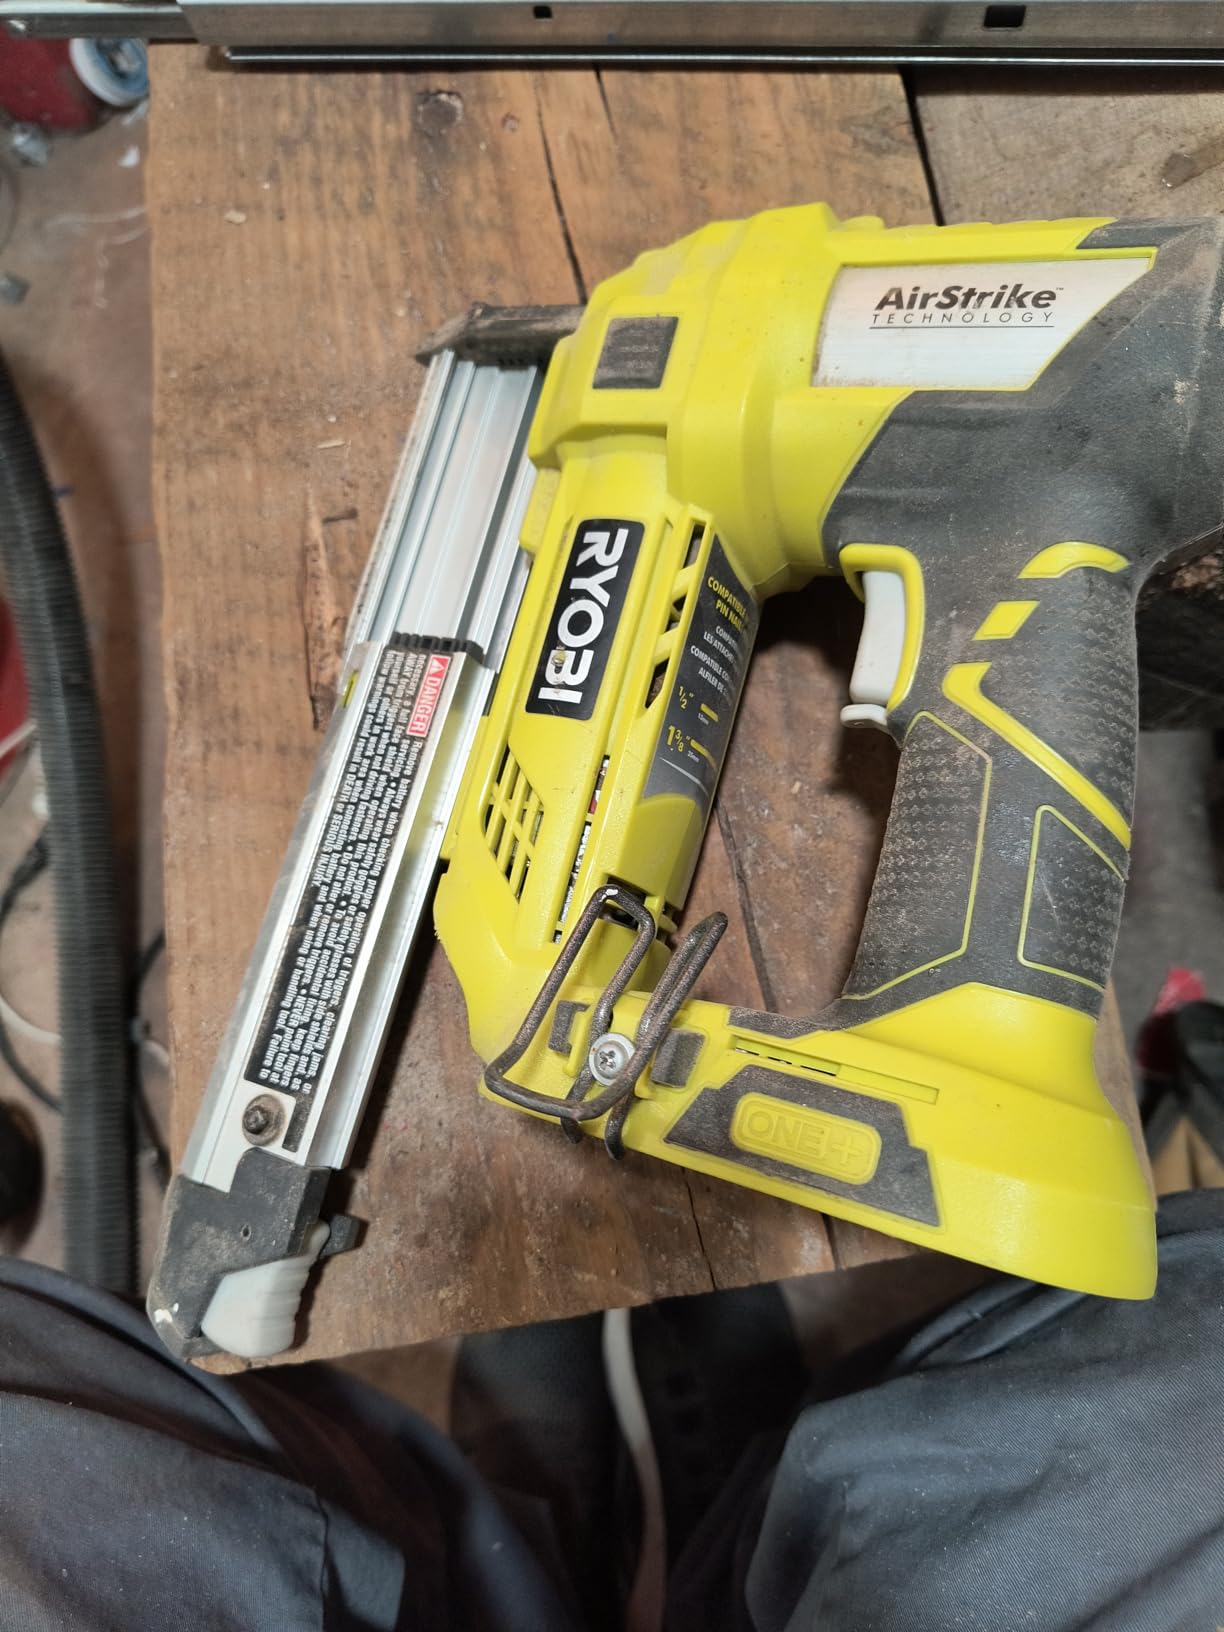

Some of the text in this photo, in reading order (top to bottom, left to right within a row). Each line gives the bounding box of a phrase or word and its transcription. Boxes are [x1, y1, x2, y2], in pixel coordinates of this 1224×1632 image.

[872, 312, 1054, 324] TECHNOLOGY
[537, 528, 629, 704] RYOBI
[715, 599, 730, 618] PIN
[703, 631, 714, 645] LES
[379, 649, 396, 675] follow
[386, 650, 406, 684] yourself
[401, 652, 417, 677] AWAY
[690, 645, 722, 676] COMPATIBLE
[365, 675, 388, 713] warnings
[384, 686, 393, 695] or
[395, 677, 409, 697] from
[375, 696, 391, 723] others
[382, 698, 403, 731] triggers
[397, 708, 410, 723] full
[410, 676, 441, 732] DANGER
[359, 714, 375, 737] could
[371, 725, 382, 734] in
[391, 724, 404, 743] face
[350, 738, 367, 763] result
[364, 736, 379, 757] work
[376, 731, 392, 755] when
[347, 762, 359, 773] in
[357, 758, 370, 777] area
[371, 755, 384, 770] not
[381, 745, 398, 772] shield
[403, 741, 422, 775] Remove
[338, 773, 356, 802] DEATH
[349, 779, 365, 803] when
[360, 770, 379, 800] driving
[373, 774, 388, 797] when
[391, 777, 410, 808] battery
[334, 803, 345, 813] or
[376, 787, 396, 819] Always
[332, 804, 357, 850] connecting
[358, 799, 380, 840] operating
[370, 819, 384, 842] wear
[384, 811, 400, 835] when
[321, 813, 343, 852] SERIOUS
[340, 851, 353, 865] Do
[353, 842, 366, 859] this
[360, 841, 378, 868] safety
[369, 837, 391, 876] checking
[321, 852, 341, 883] battery
[335, 865, 348, 881] not
[317, 884, 331, 902] and
[328, 881, 343, 902] alter
[348, 869, 369, 904] goggles
[358, 878, 377, 909] proper
[308, 903, 325, 928] when
[324, 903, 335, 913] or
[333, 908, 345, 919] To
[346, 905, 356, 915] or
[313, 914, 331, 947] remove
[325, 921, 341, 947] avoid
[336, 915, 355, 943] safety
[344, 911, 368, 954] operation
[298, 929, 316, 955] using
[295, 956, 306, 967] or
[309, 948, 332, 996] accidental
[324, 943, 346, 979] glasses
[341, 956, 354, 967] of
[280, 968, 303, 1008] handling
[319, 979, 334, 999] with
[287, 995, 306, 1027] NEVER
[312, 1000, 328, 1020] side
[278, 1027, 296, 1052] point
[289, 1027, 307, 1052] keep
[301, 1020, 321, 1055] shields
[313, 1011, 336, 1050] clearing
[262, 1033, 282, 1067] Failure
[273, 1052, 288, 1071] tool
[258, 1068, 271, 1080] to
[269, 1071, 282, 1083] at
[278, 1053, 299, 1087] fingers
[290, 1077, 301, 1090] as
[301, 1082, 313, 1094] or
